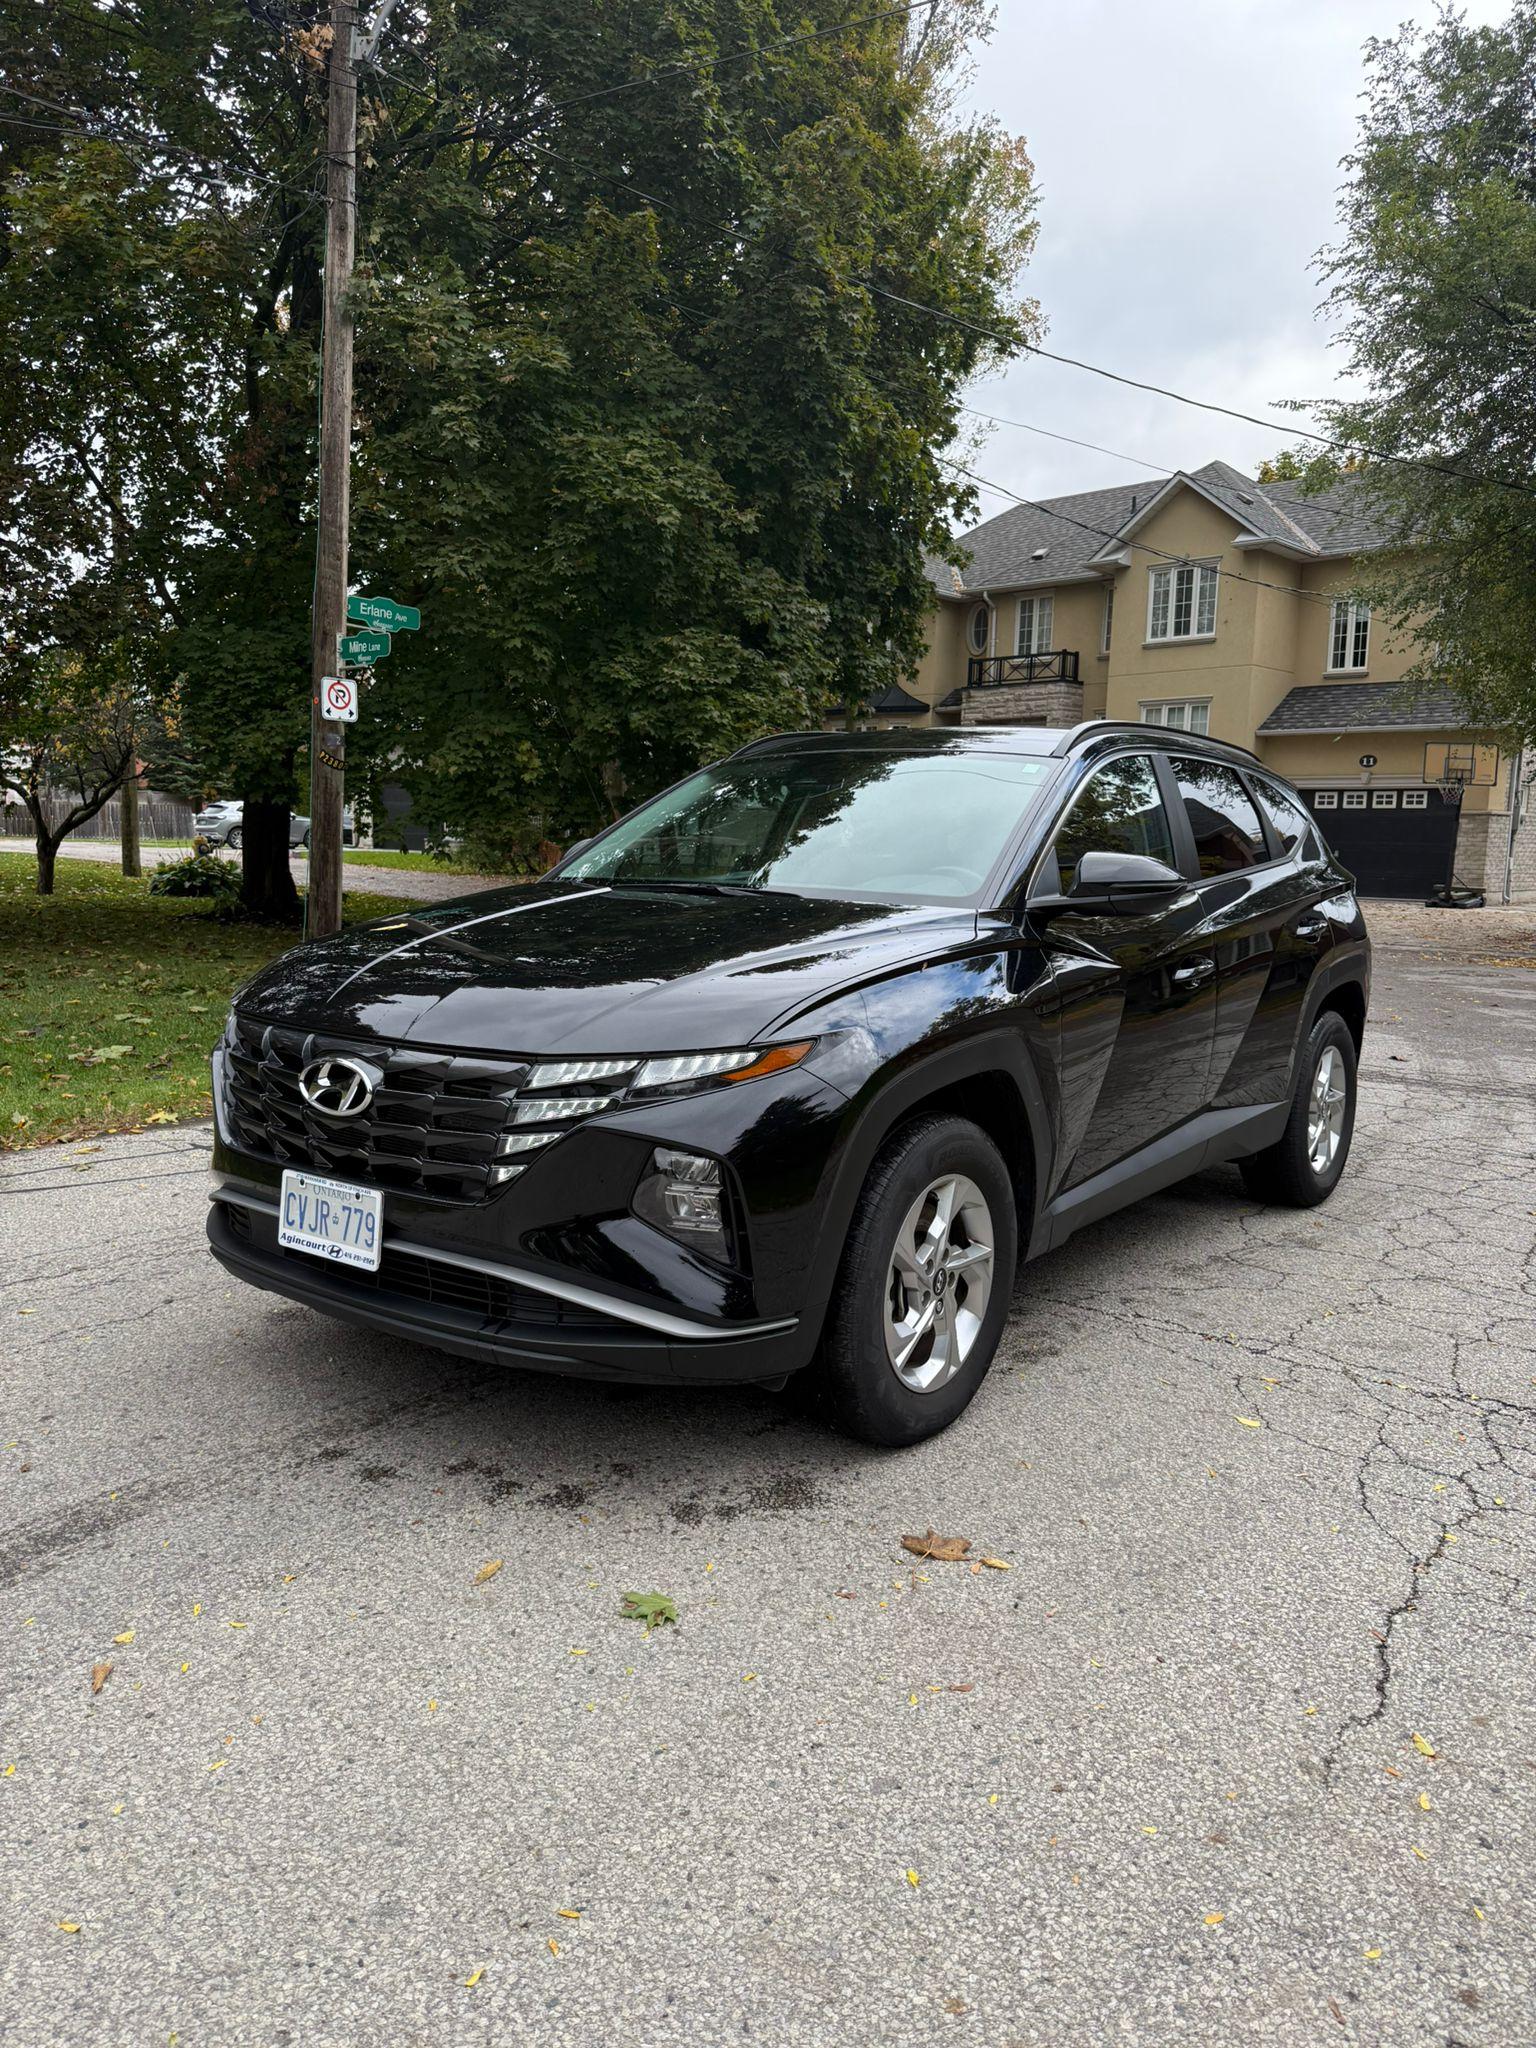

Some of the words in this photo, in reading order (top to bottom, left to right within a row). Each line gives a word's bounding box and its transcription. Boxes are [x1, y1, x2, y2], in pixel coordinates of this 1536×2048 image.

[360, 602, 393, 619] Erlane
[395, 613, 408, 623] Ave
[368, 643, 381, 652] Lane
[1362, 757, 1374, 766] 11
[313, 1185, 351, 1201] ONTARIO
[286, 1192, 330, 1237] CVJR
[342, 1205, 376, 1248] 779
[280, 1232, 327, 1252] Agincourt
